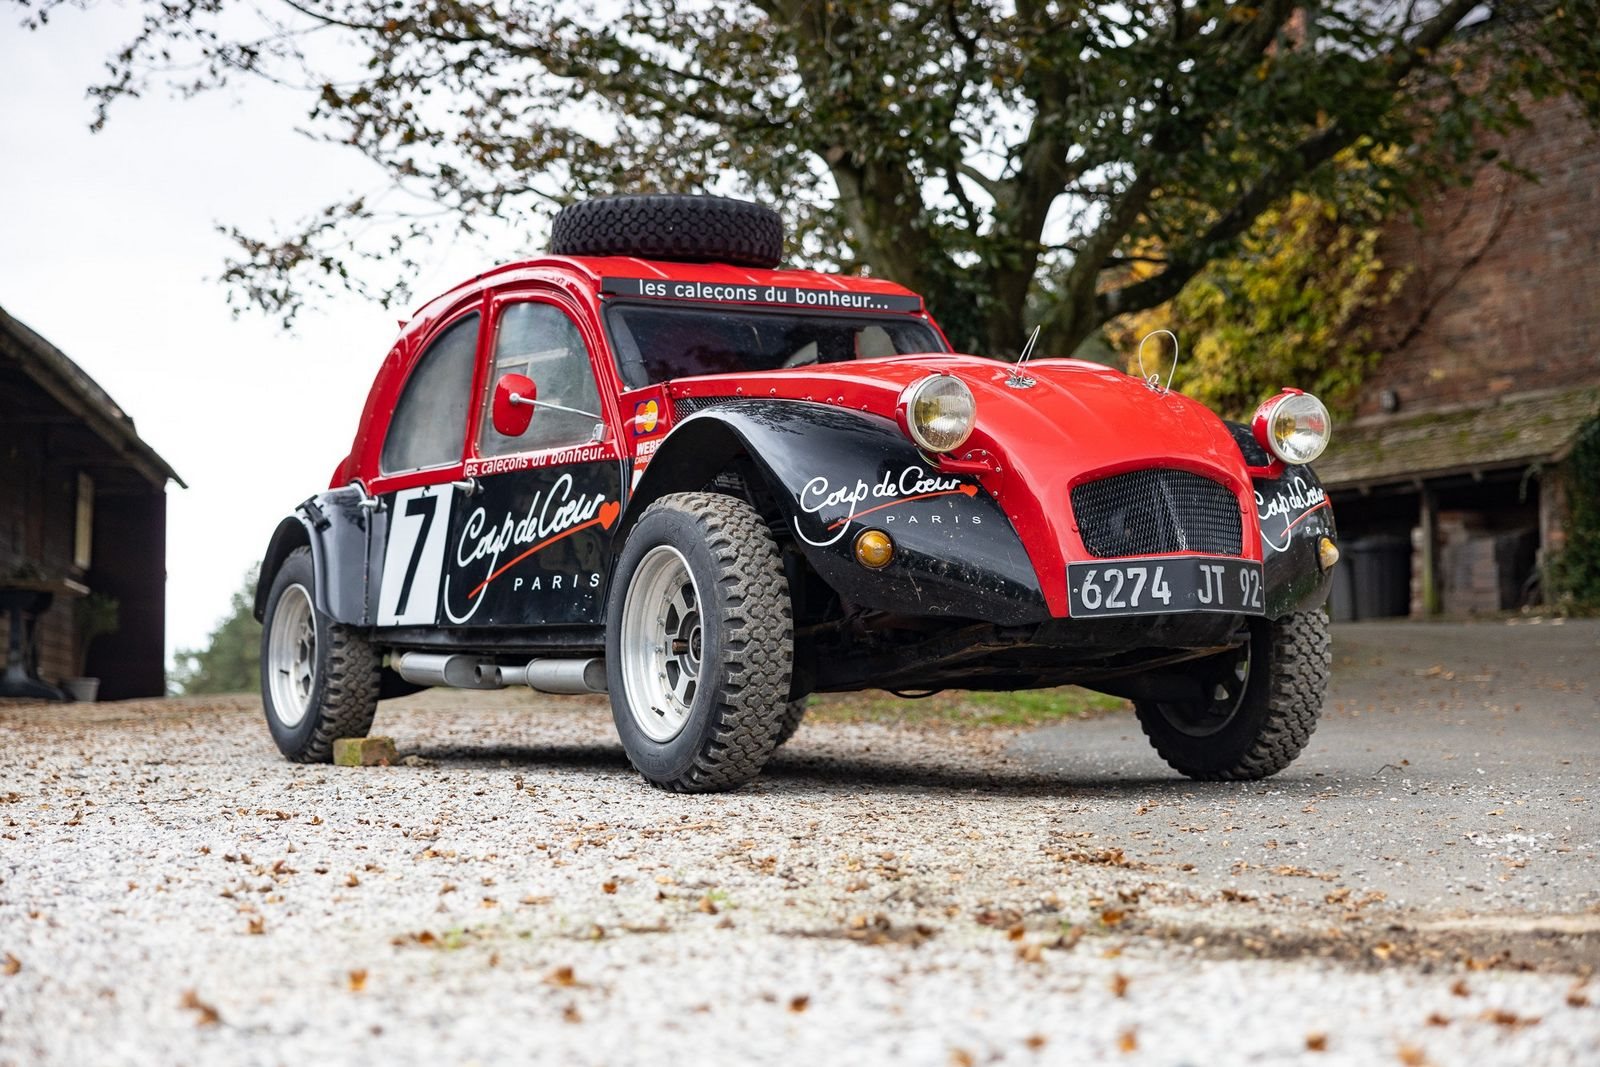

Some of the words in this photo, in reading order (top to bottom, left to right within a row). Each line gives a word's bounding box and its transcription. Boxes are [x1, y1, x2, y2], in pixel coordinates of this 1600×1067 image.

[639, 279, 666, 296] les
[674, 282, 757, 301] caleçons
[765, 287, 787, 303] du
[795, 288, 889, 309] bonheur...
[463, 461, 478, 477] les
[481, 456, 528, 474] caleçons
[532, 452, 546, 467] du
[551, 447, 615, 465] bonheur...
[794, 477, 868, 547] Coup
[872, 471, 898, 498] de
[1287, 483, 1304, 509] de
[886, 515, 981, 524] PARIS
[1305, 526, 1330, 536] PAR
[394, 495, 439, 617] 7
[444, 507, 514, 624] Coup
[514, 491, 541, 546] de
[514, 573, 600, 591] PARIS
[1081, 566, 1171, 610] 6274
[1198, 565, 1225, 605] JT
[1240, 568, 1261, 608] 92
